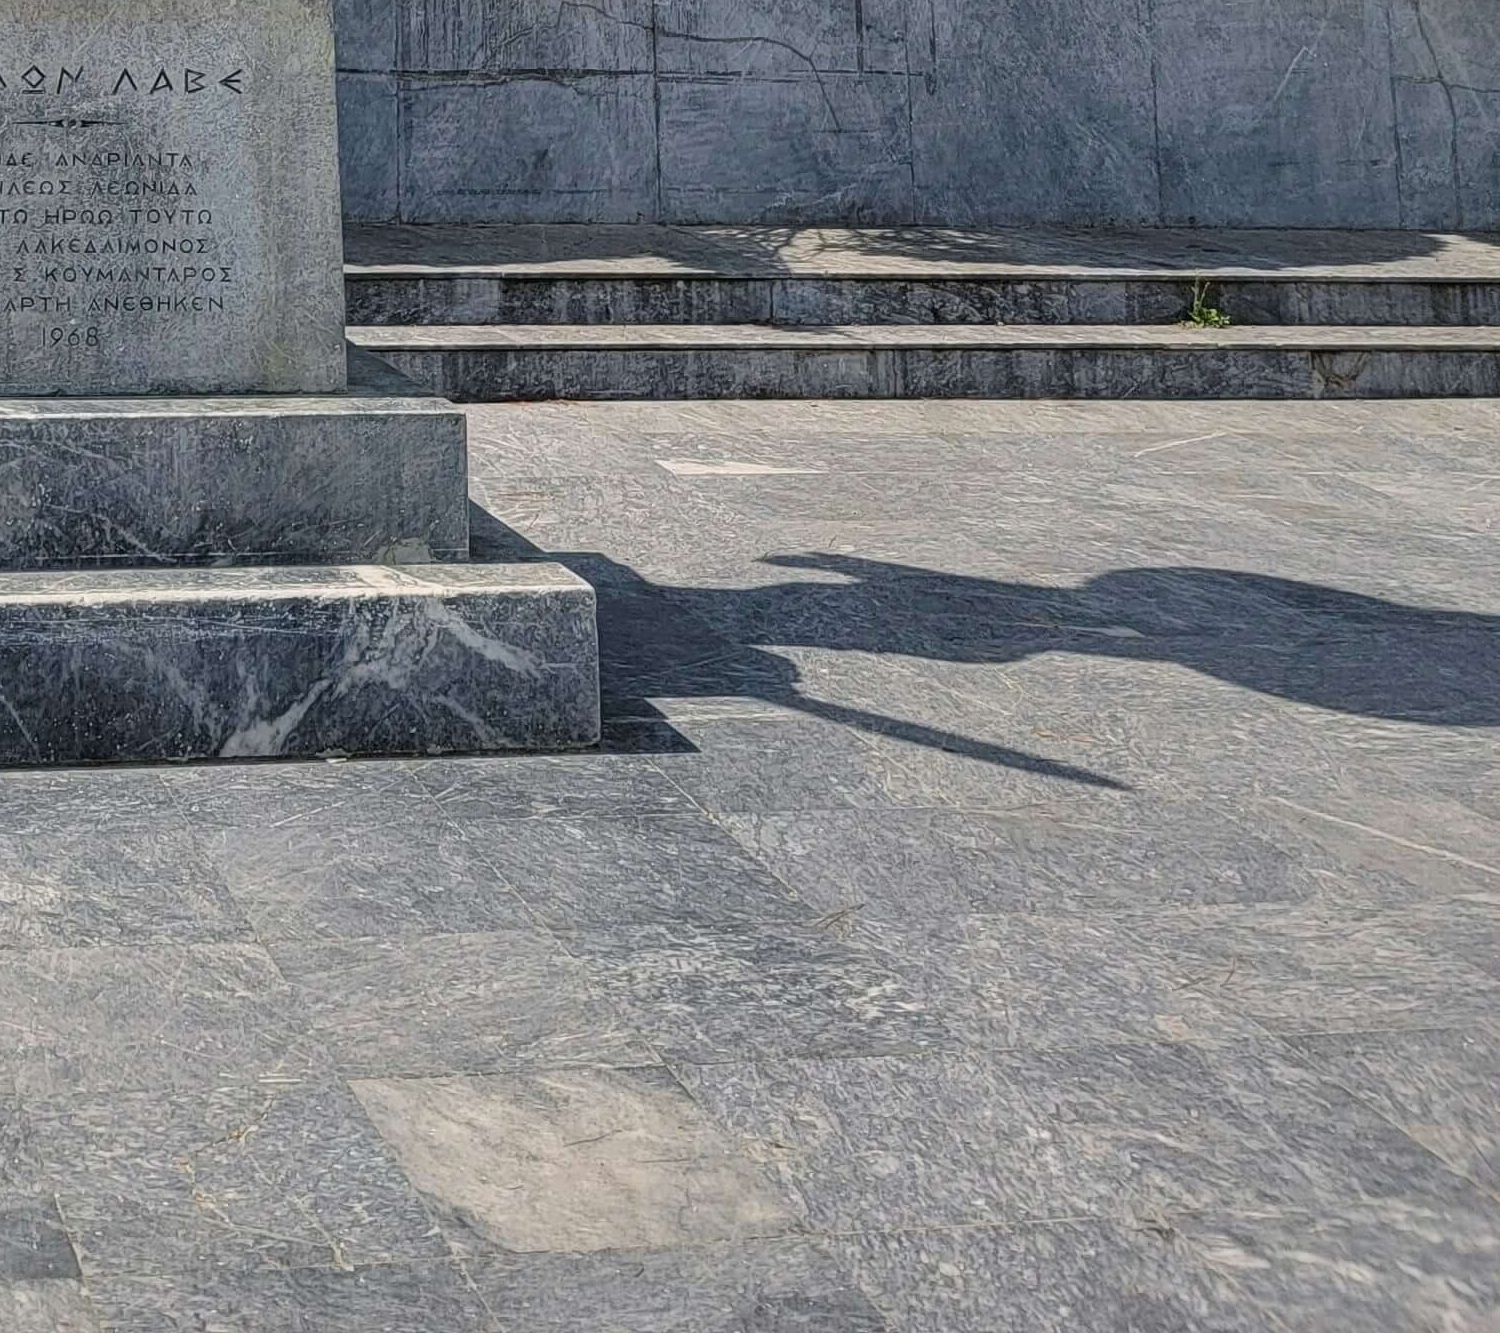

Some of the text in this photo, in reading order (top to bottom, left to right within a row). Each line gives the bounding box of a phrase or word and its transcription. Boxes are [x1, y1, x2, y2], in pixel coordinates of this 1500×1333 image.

[112, 67, 243, 95] ΛΑΒΕ
[55, 151, 193, 168] ΑΝΔΡΙΑΝΤΑ
[91, 180, 198, 196] ΛΕΩΝΙΔΑ
[44, 209, 113, 225] ΗΡΩΩ
[129, 209, 213, 225] ΤΟΥΤΩ
[16, 238, 210, 254] ΛΑΚΕΔΑΙΜΟΝΟΣ
[44, 267, 233, 283] ΚΟΥΜΑΝΤΑΡΟΣ
[87, 296, 224, 312] ΑΝΕΘΗΚΕΝ
[42, 326, 100, 347] 1968
